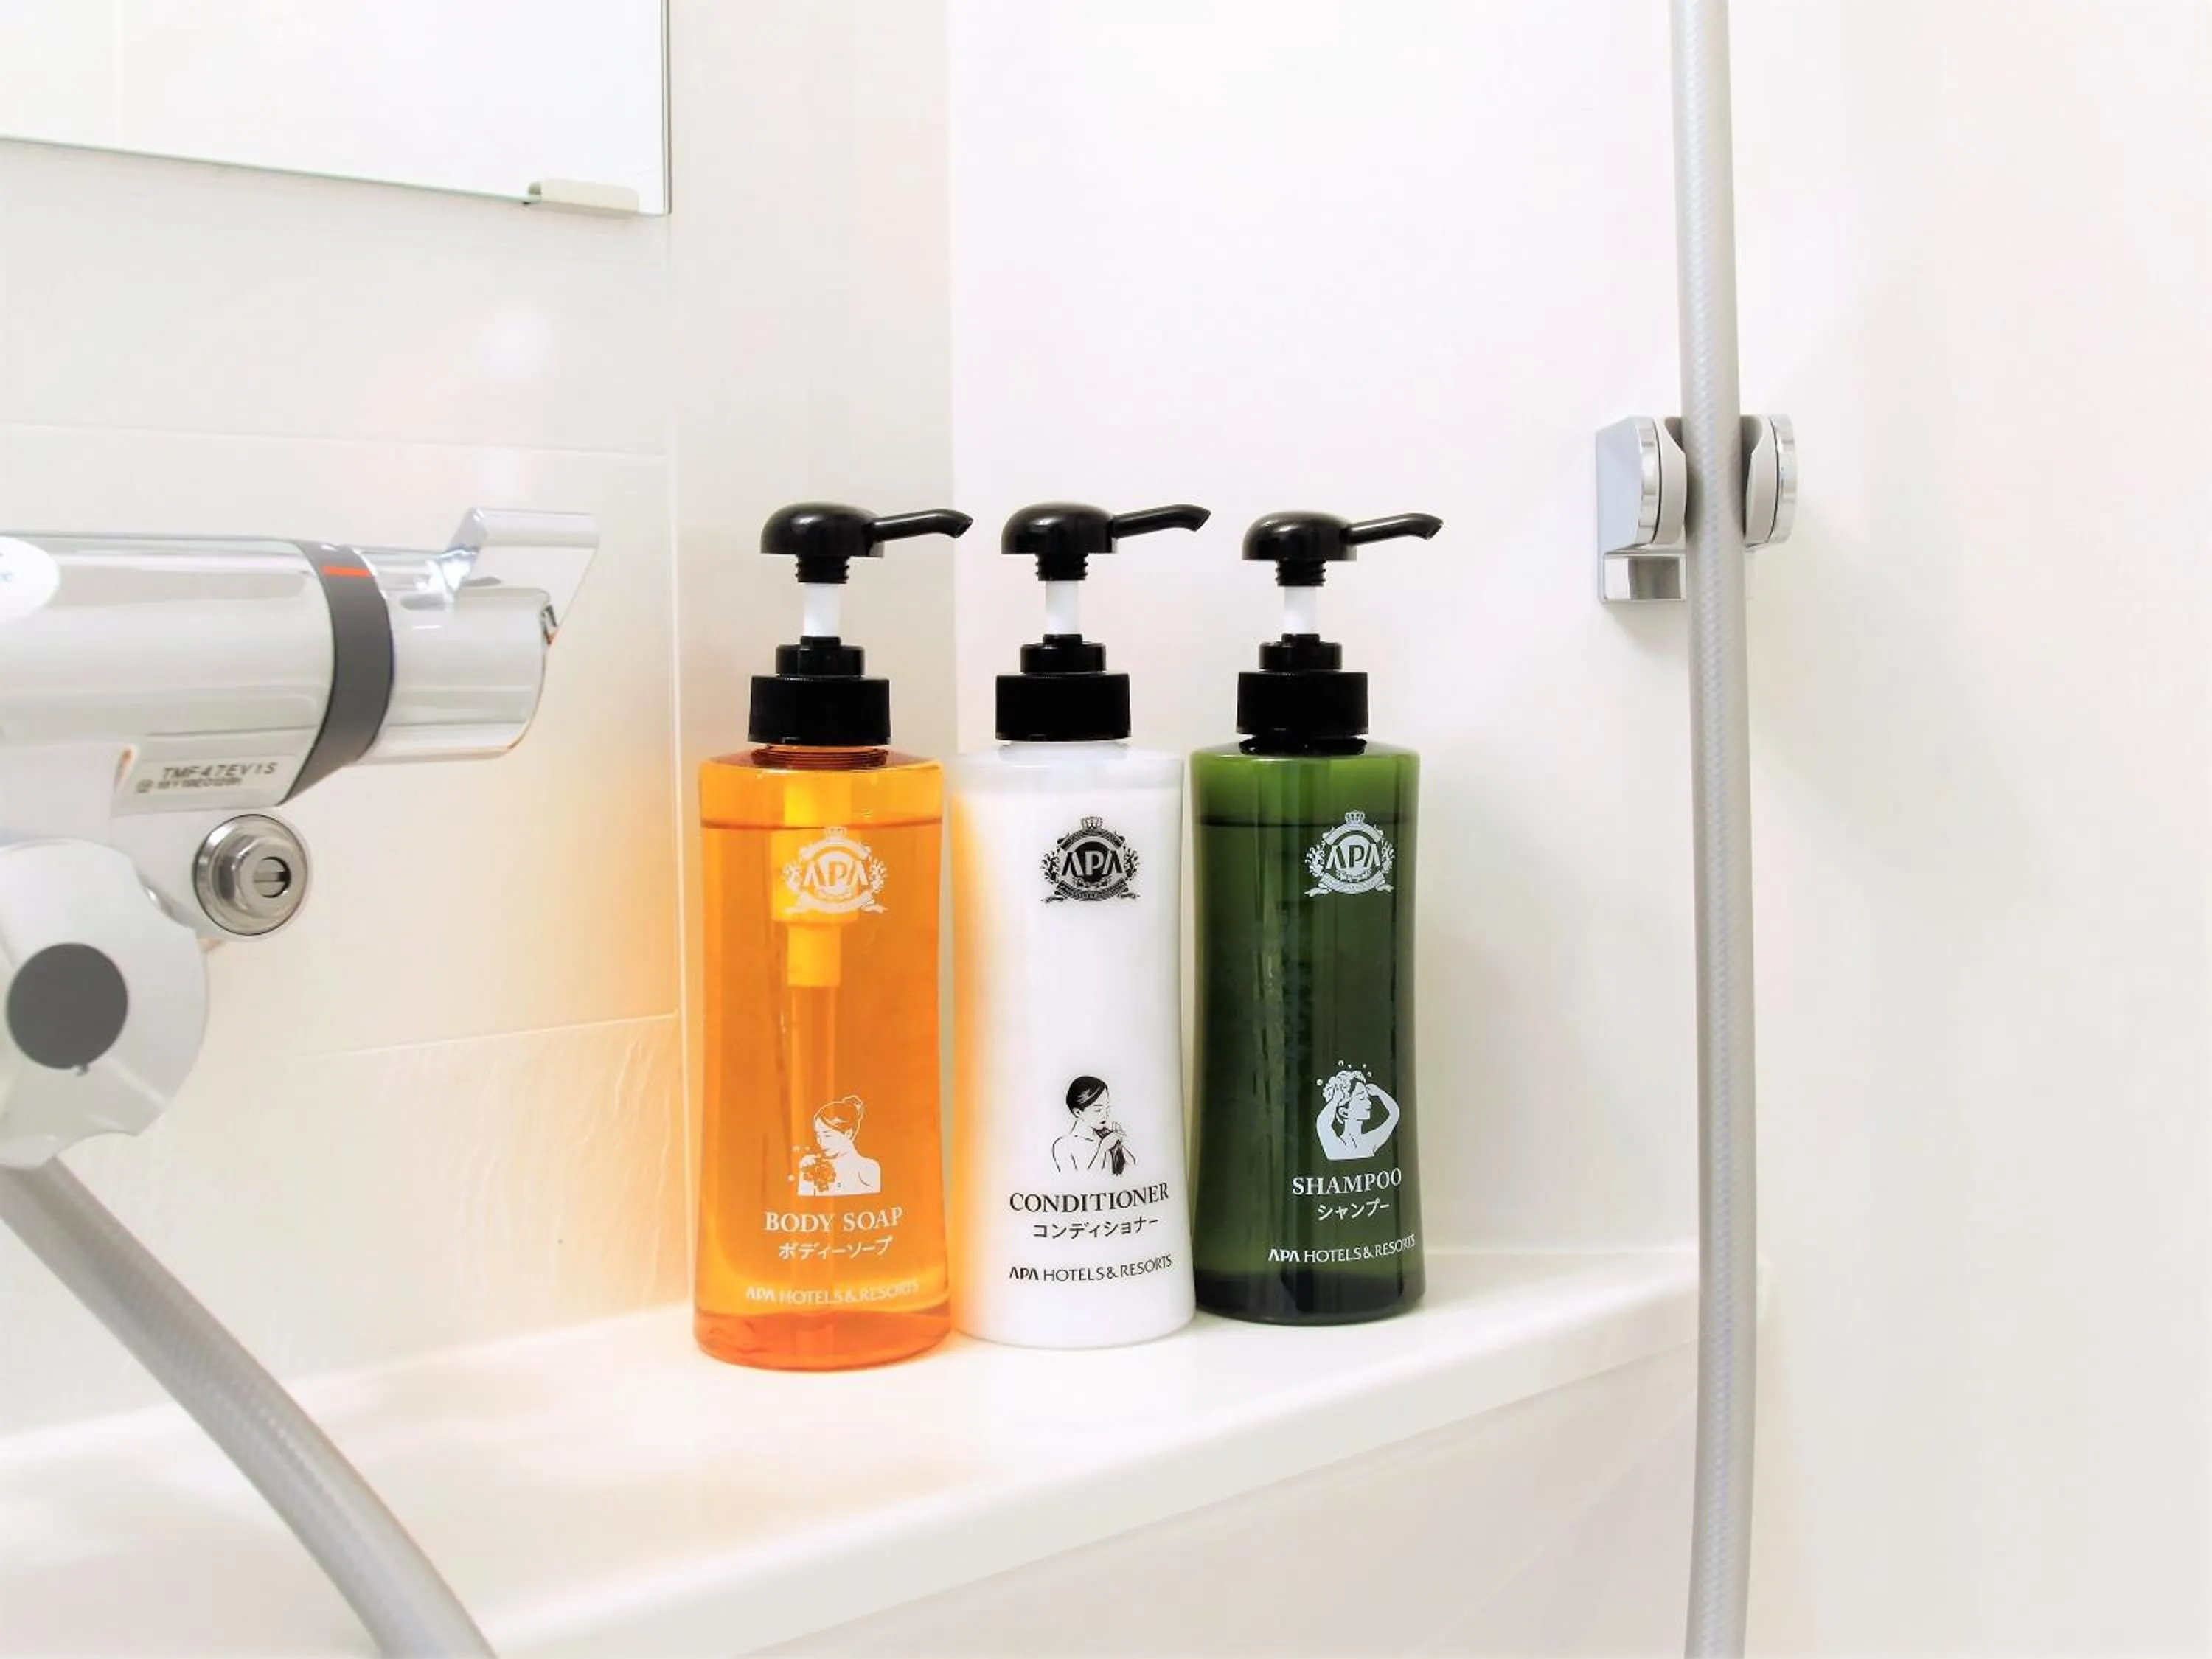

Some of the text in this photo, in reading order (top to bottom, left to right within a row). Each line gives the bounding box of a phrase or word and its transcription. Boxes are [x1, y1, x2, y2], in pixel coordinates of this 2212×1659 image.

[1062, 849, 1122, 878] APA
[1326, 843, 1381, 870] APA
[803, 860, 869, 888] APA
[1293, 1168, 1402, 1195] SHAMPOO
[1009, 1182, 1169, 1214] CONDITIONER
[1318, 1198, 1390, 1221] シャンプー
[765, 1206, 903, 1233] BODY SOAP
[1033, 1216, 1159, 1239] コンディショナー
[779, 1235, 894, 1260] ボディーソープ
[1268, 1248, 1300, 1262] APA
[1009, 1266, 1039, 1281] APA
[746, 1286, 775, 1301] APA
